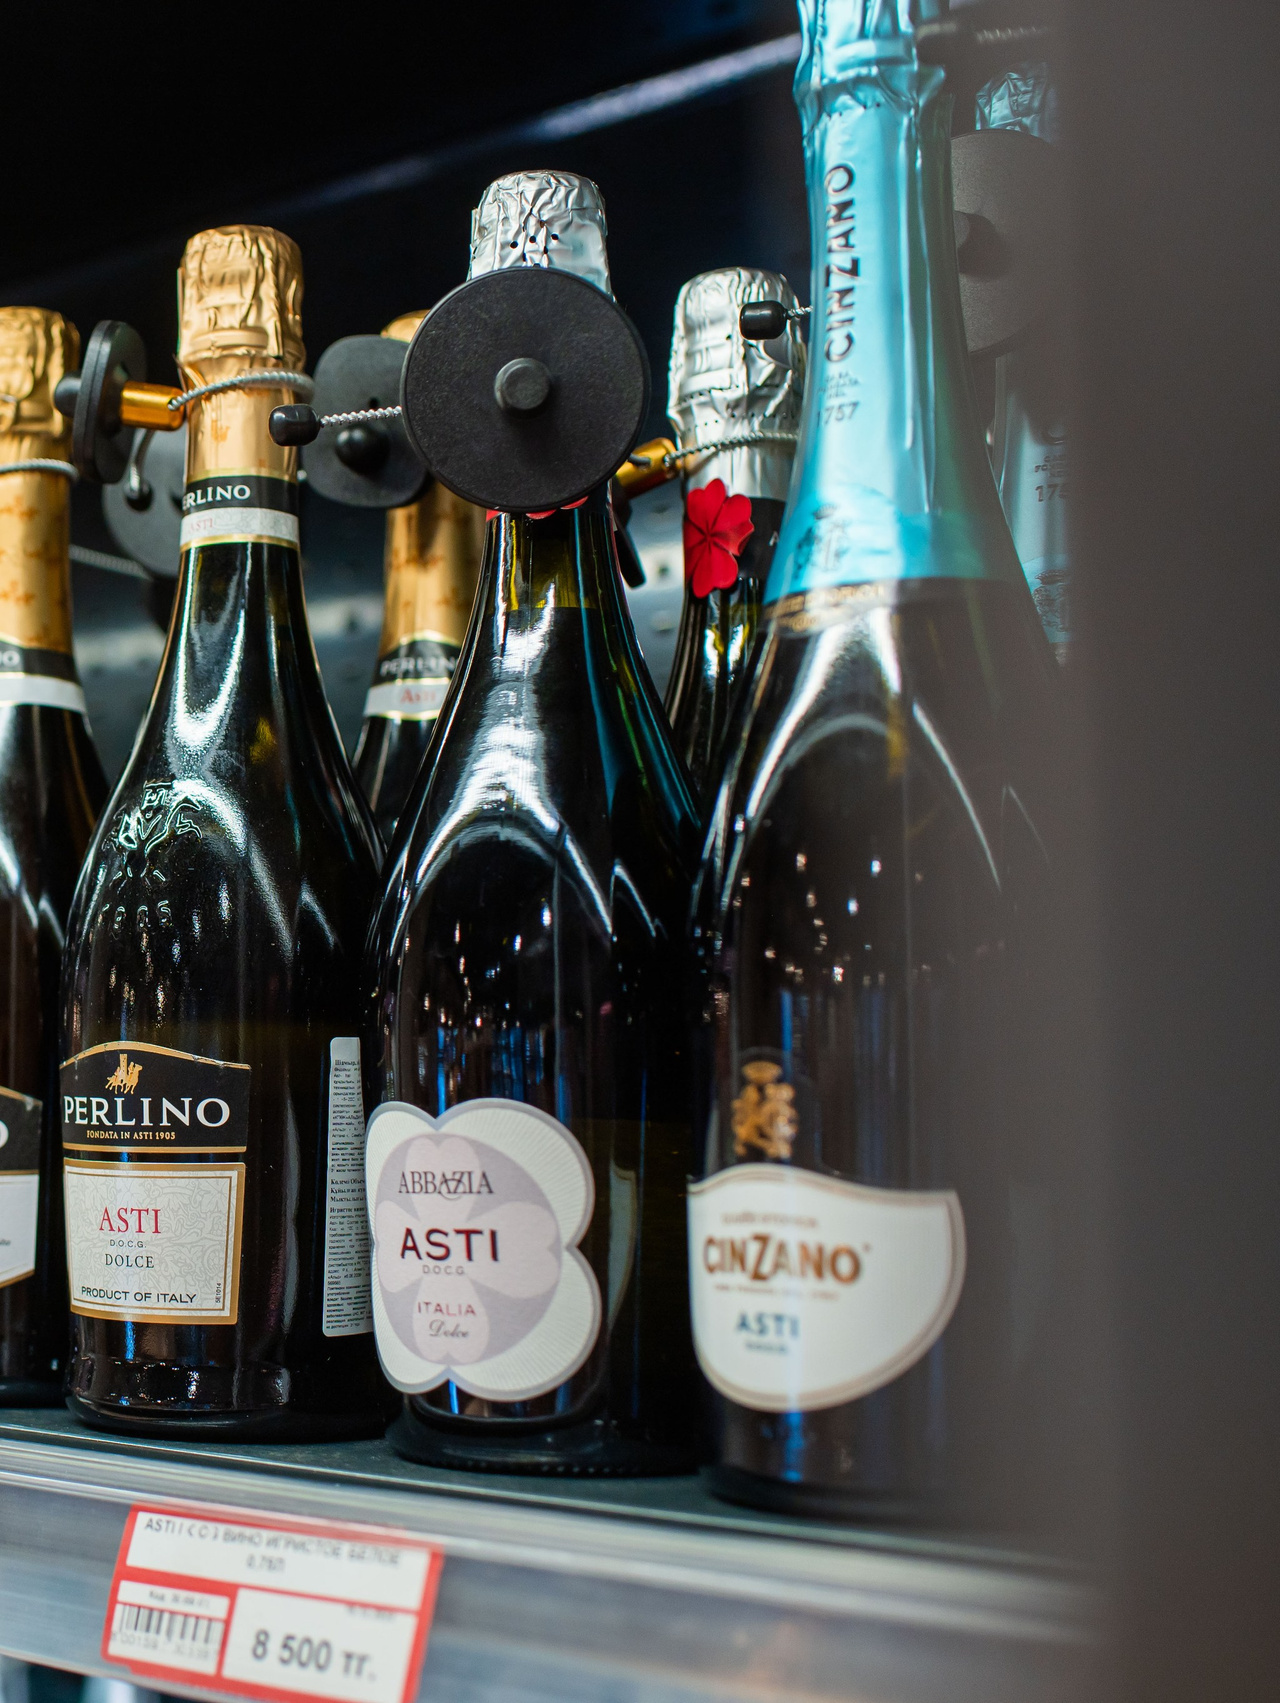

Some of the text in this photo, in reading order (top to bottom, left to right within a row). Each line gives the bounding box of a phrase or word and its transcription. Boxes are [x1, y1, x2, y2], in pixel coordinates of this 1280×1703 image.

[823, 162, 861, 363] CINZANO
[380, 656, 459, 677] PERLIN
[63, 1095, 231, 1128] PERLINO
[86, 1130, 119, 1140] FONDATA
[120, 1131, 130, 1140] IN
[133, 1131, 153, 1140] ASTI
[398, 1171, 494, 1200] ABBAZIA
[99, 1206, 162, 1234] ASTI
[109, 1239, 147, 1249] D.O.C.G.
[400, 1227, 500, 1263] ASTI
[104, 1253, 155, 1269] DOLCE
[703, 1232, 862, 1286] CINZANO
[81, 1286, 197, 1304] PRODUCT OF ITALY
[417, 1301, 477, 1317] ITALIA
[736, 1312, 800, 1339] ASTI
[251, 1629, 269, 1661] 8
[278, 1635, 332, 1673] 500
